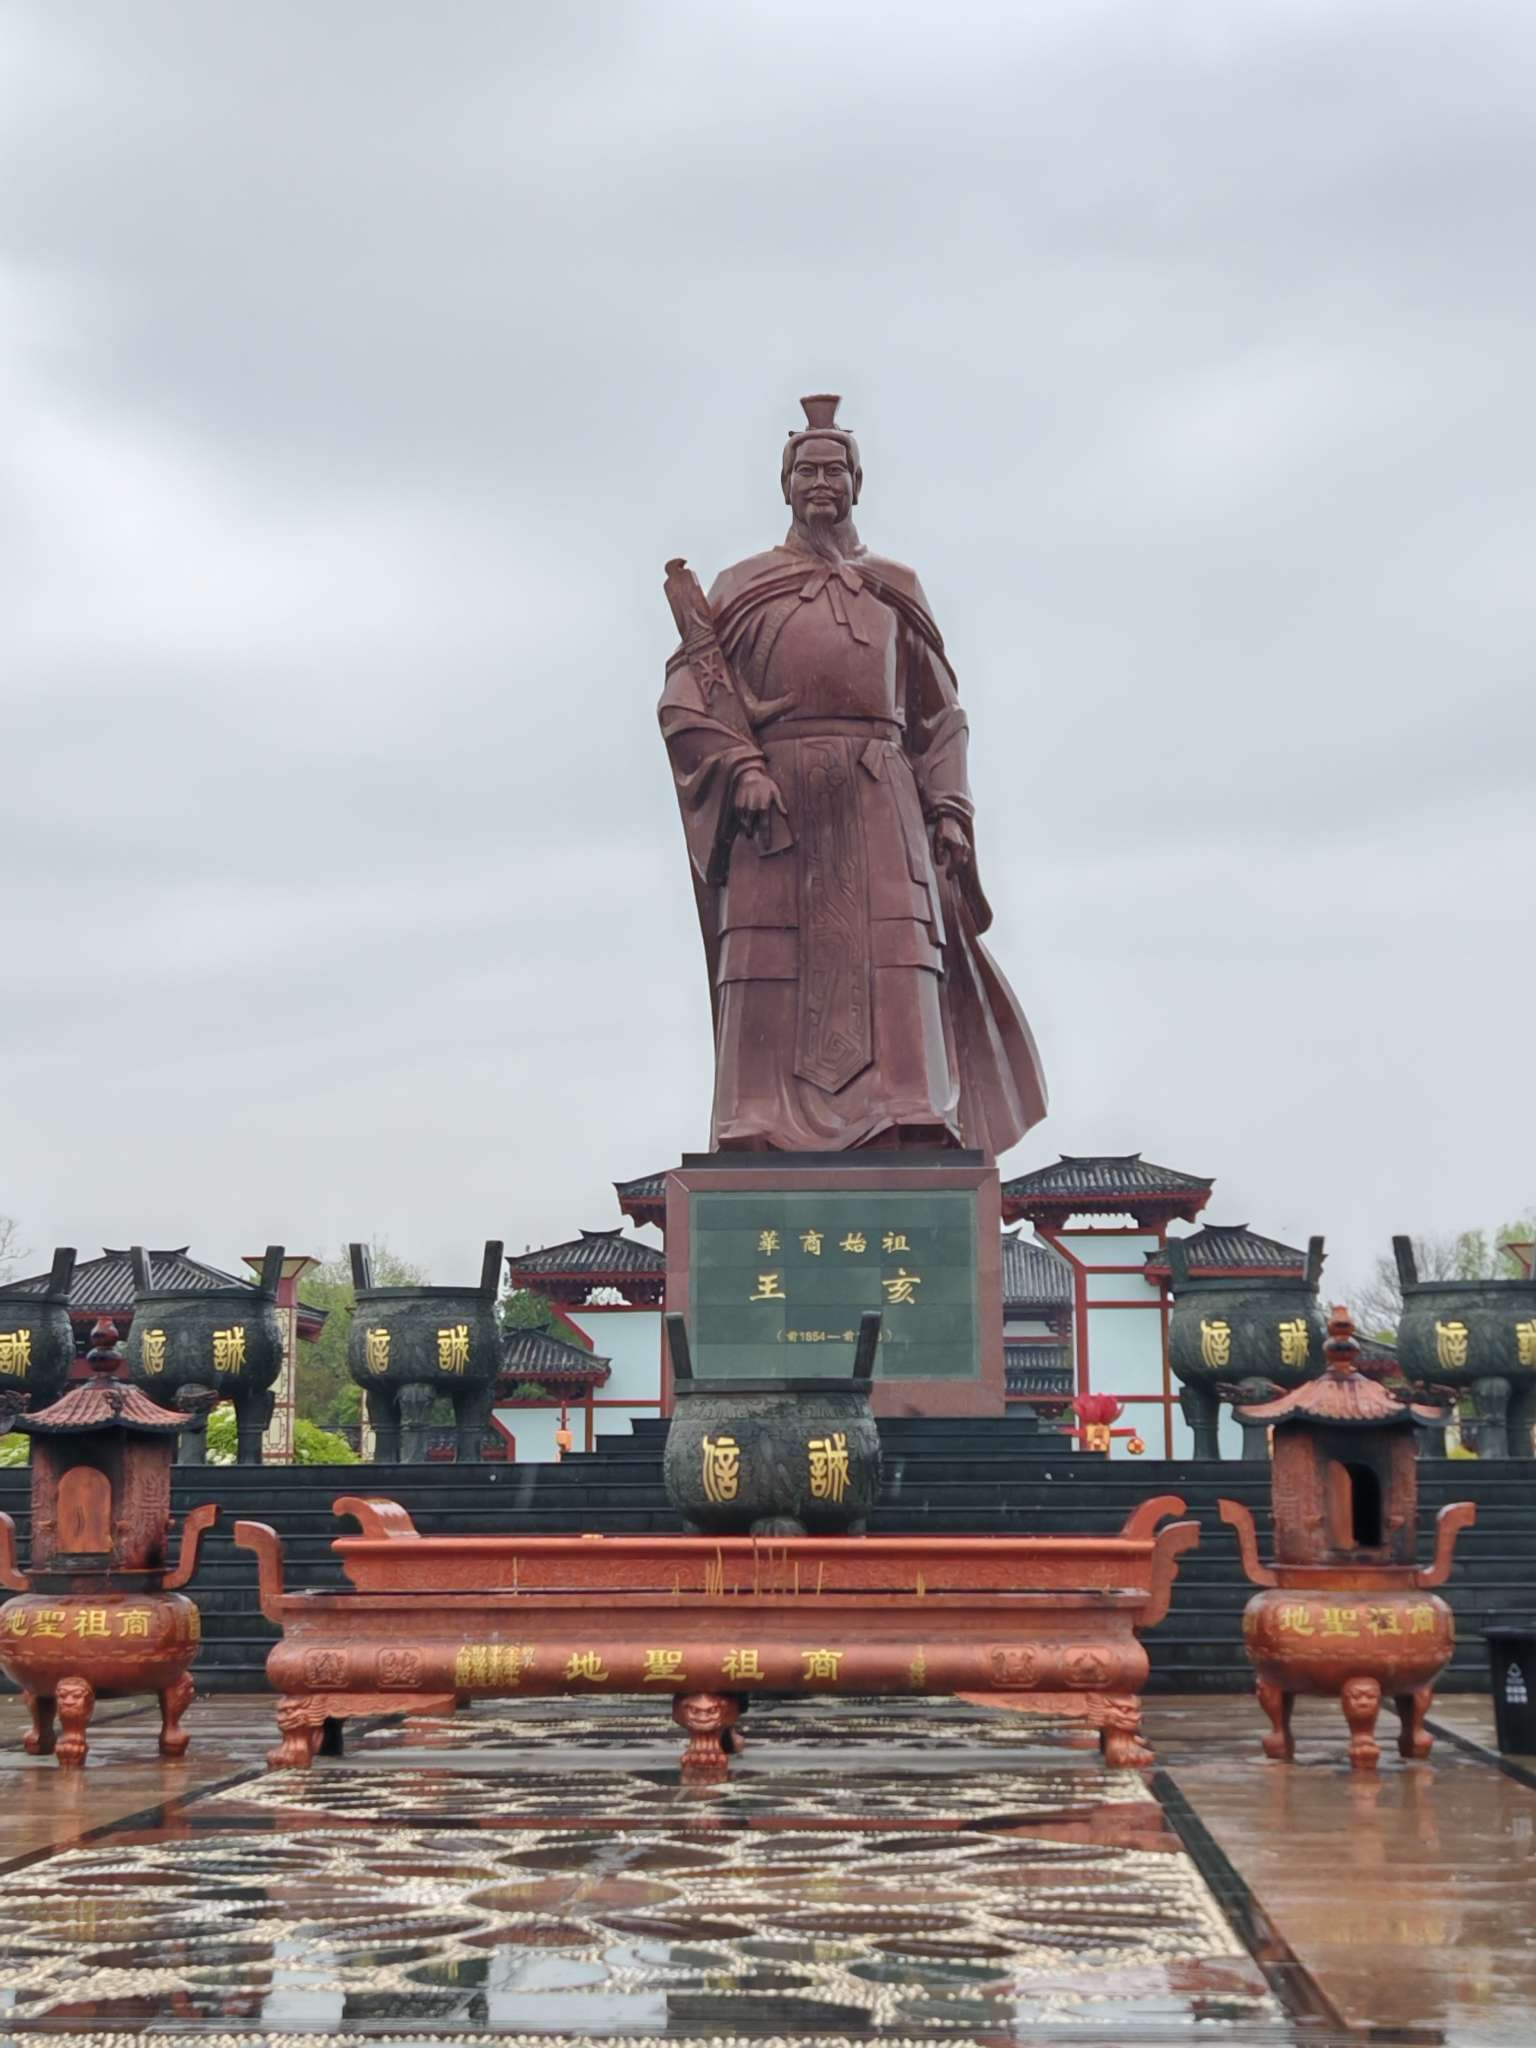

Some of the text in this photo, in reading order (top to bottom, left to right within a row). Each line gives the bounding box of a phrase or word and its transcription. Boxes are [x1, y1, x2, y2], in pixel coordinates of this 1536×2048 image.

[757, 1229, 911, 1257] 華商始祖
[749, 1267, 921, 1305] 王亥
